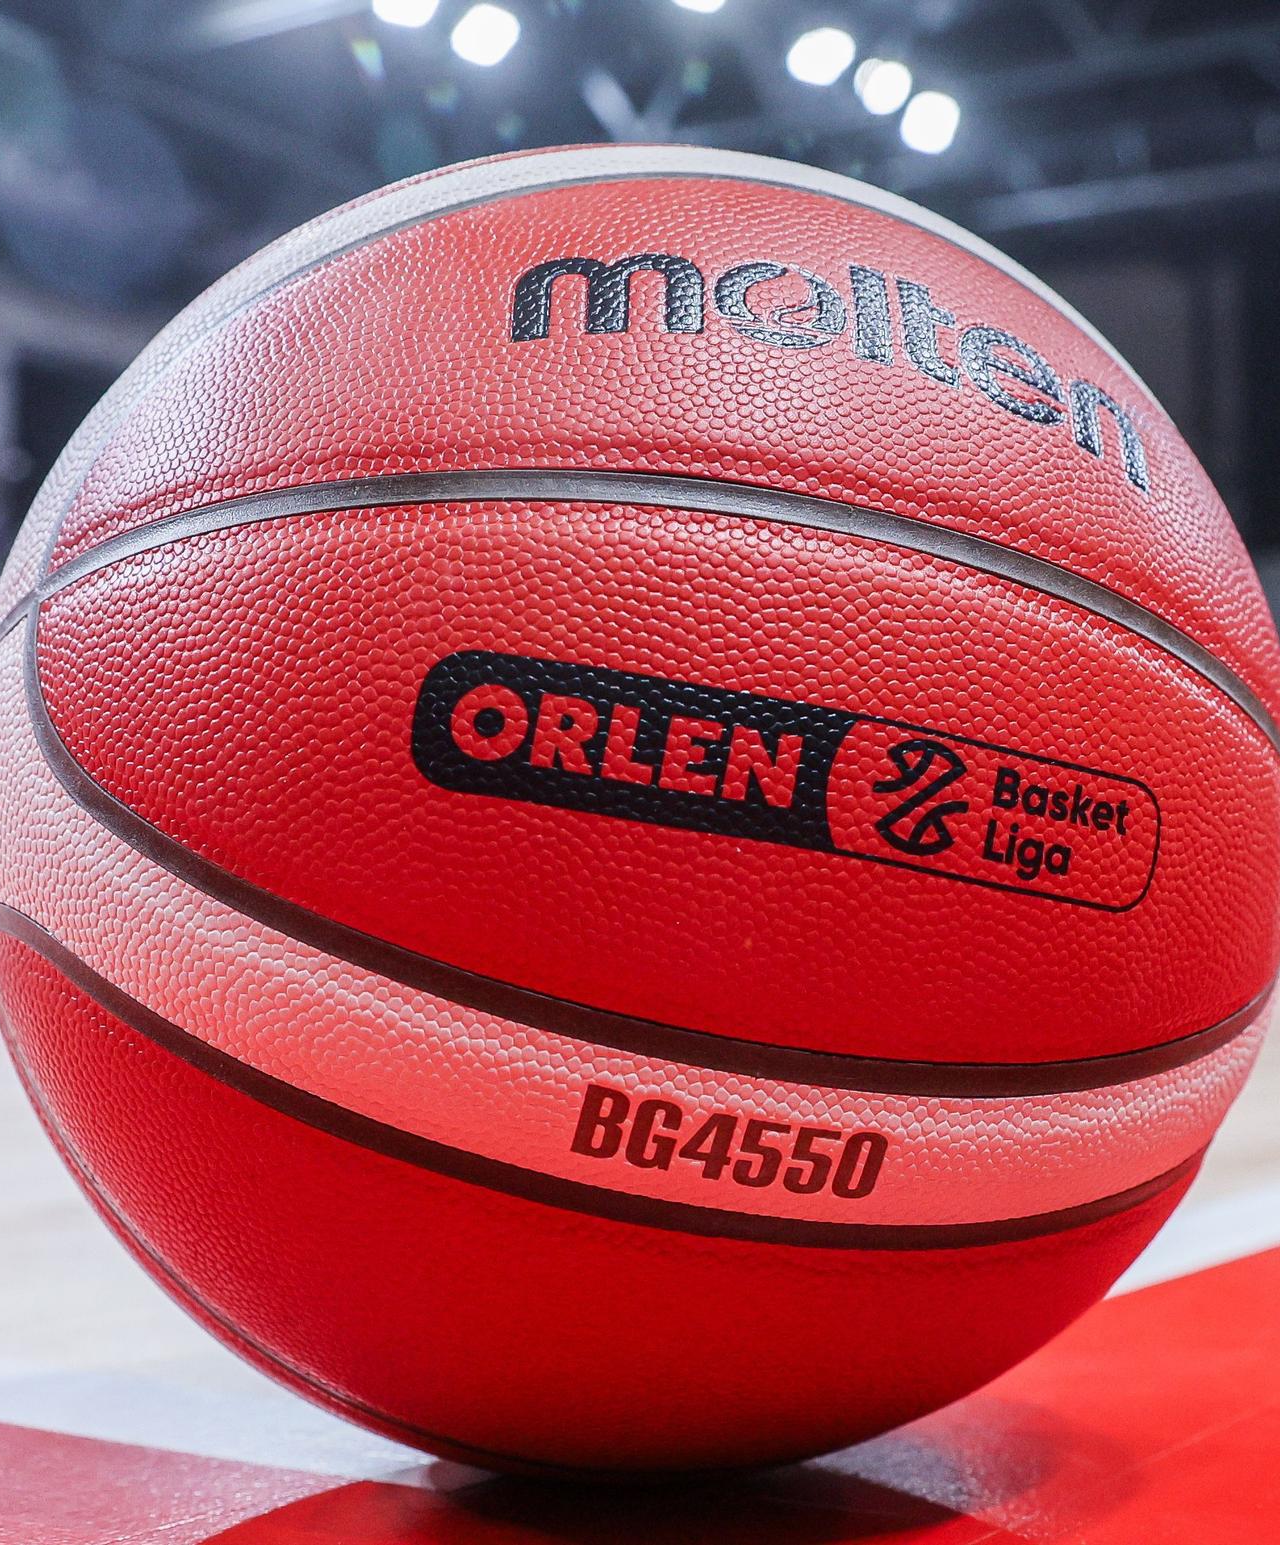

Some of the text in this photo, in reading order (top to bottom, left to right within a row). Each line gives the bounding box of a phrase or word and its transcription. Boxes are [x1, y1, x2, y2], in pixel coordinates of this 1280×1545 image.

[511, 252, 1150, 495] molten
[449, 683, 804, 809] ORLEN
[992, 767, 1129, 836] Basket
[981, 820, 1072, 881] Liga
[570, 1084, 888, 1200] BG4550
